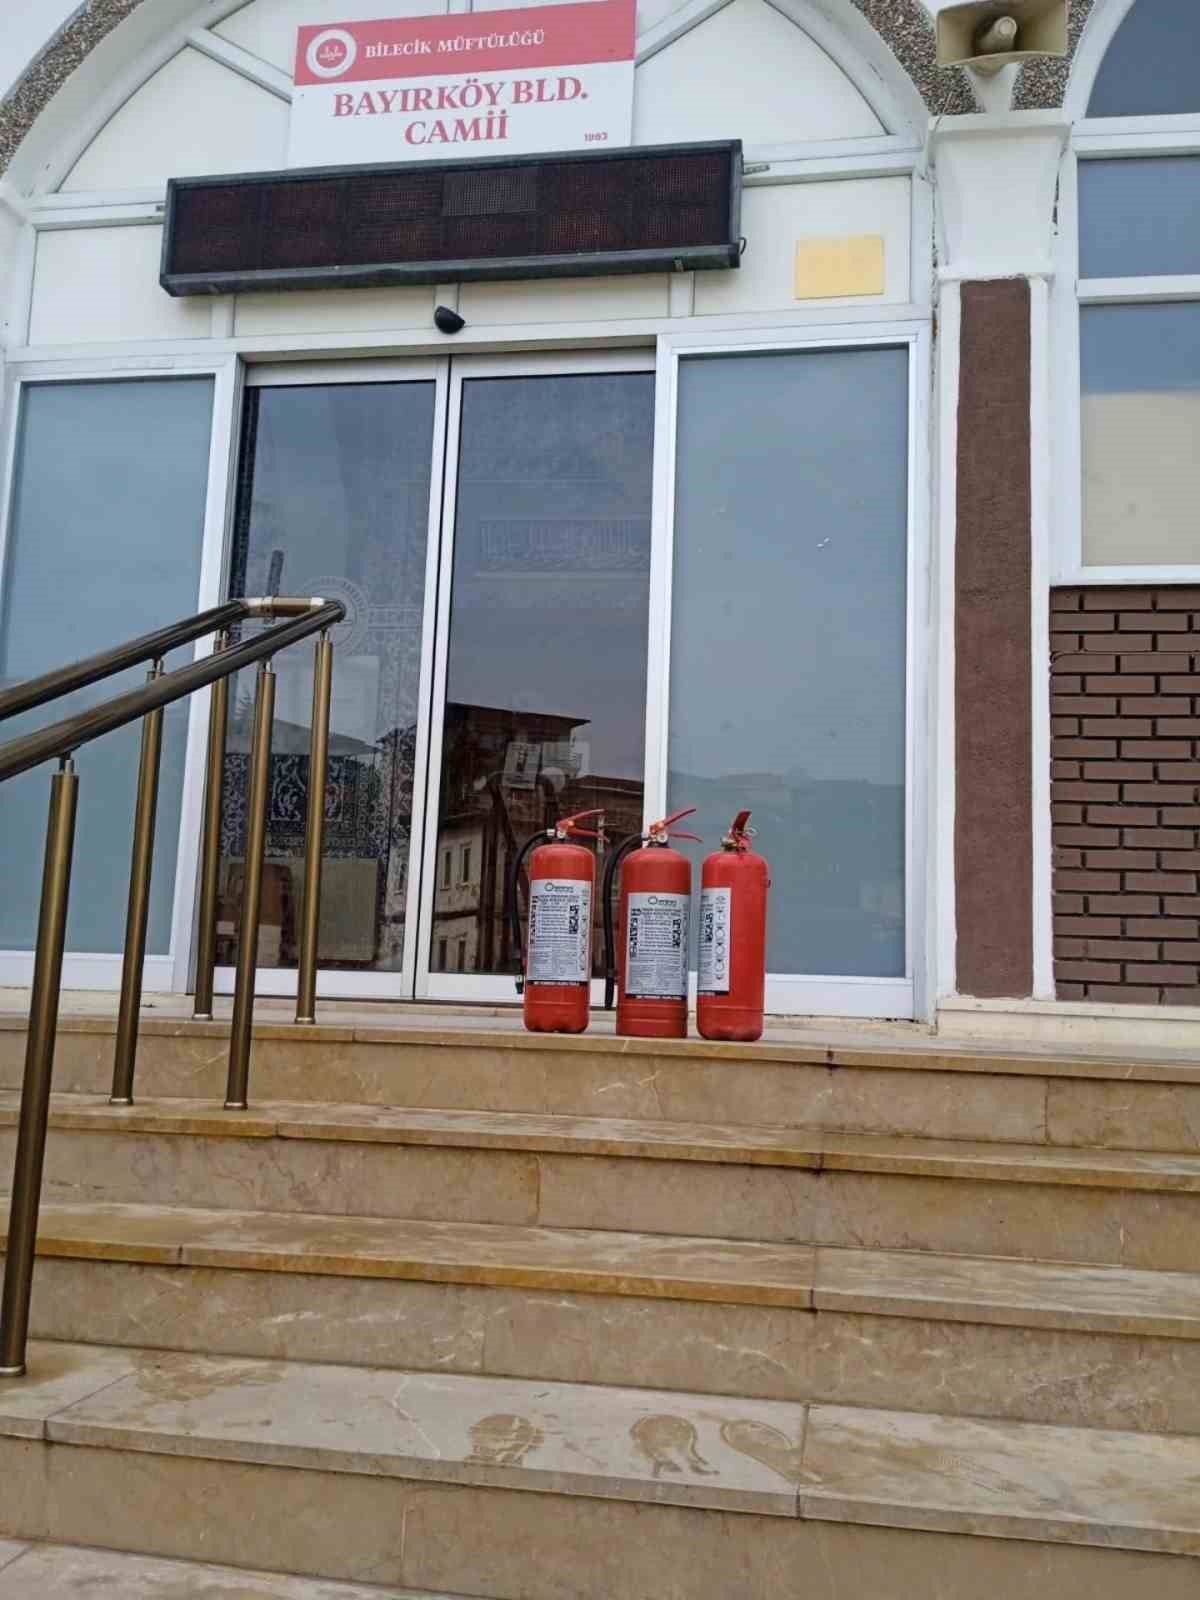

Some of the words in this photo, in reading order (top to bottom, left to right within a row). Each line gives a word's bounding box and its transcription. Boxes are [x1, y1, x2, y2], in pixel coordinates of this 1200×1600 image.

[366, 39, 432, 58] BİLECİK
[438, 29, 545, 52] MÜFTÜLÜĞÜ
[334, 78, 505, 117] BAYIRKÖY
[511, 76, 588, 104] BLD.
[405, 110, 509, 145] CAMİİ
